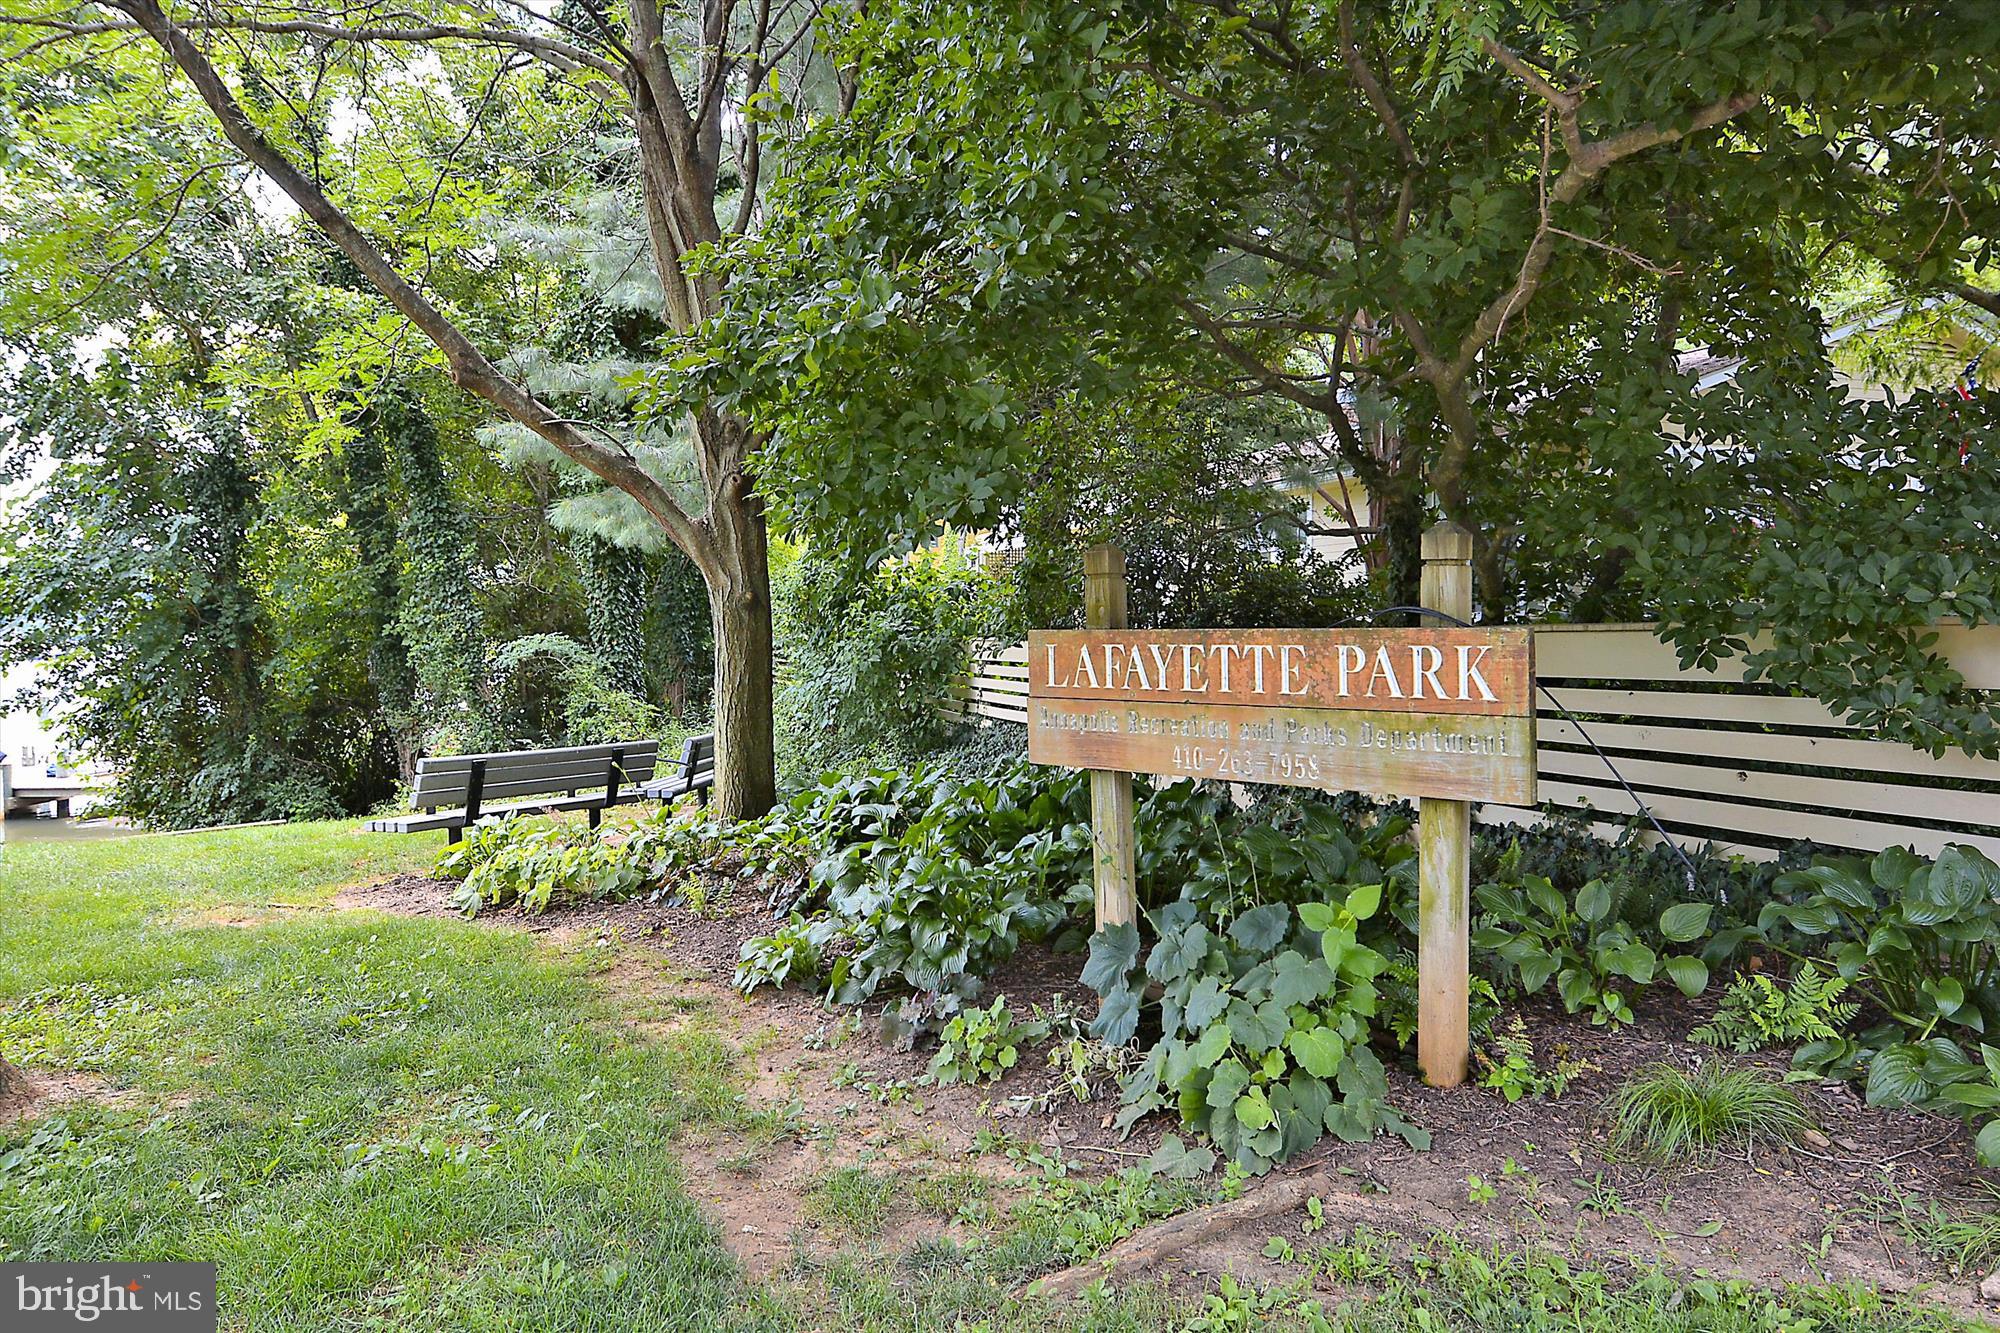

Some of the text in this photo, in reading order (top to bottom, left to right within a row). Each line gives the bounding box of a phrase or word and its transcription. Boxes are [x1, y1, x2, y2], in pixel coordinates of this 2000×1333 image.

[1045, 643, 1499, 702] LAFAYETTE PARK
[1040, 706, 1509, 755] Annapolis Recreation and Parks Department
[1172, 745, 1320, 780] 410-263-7958
